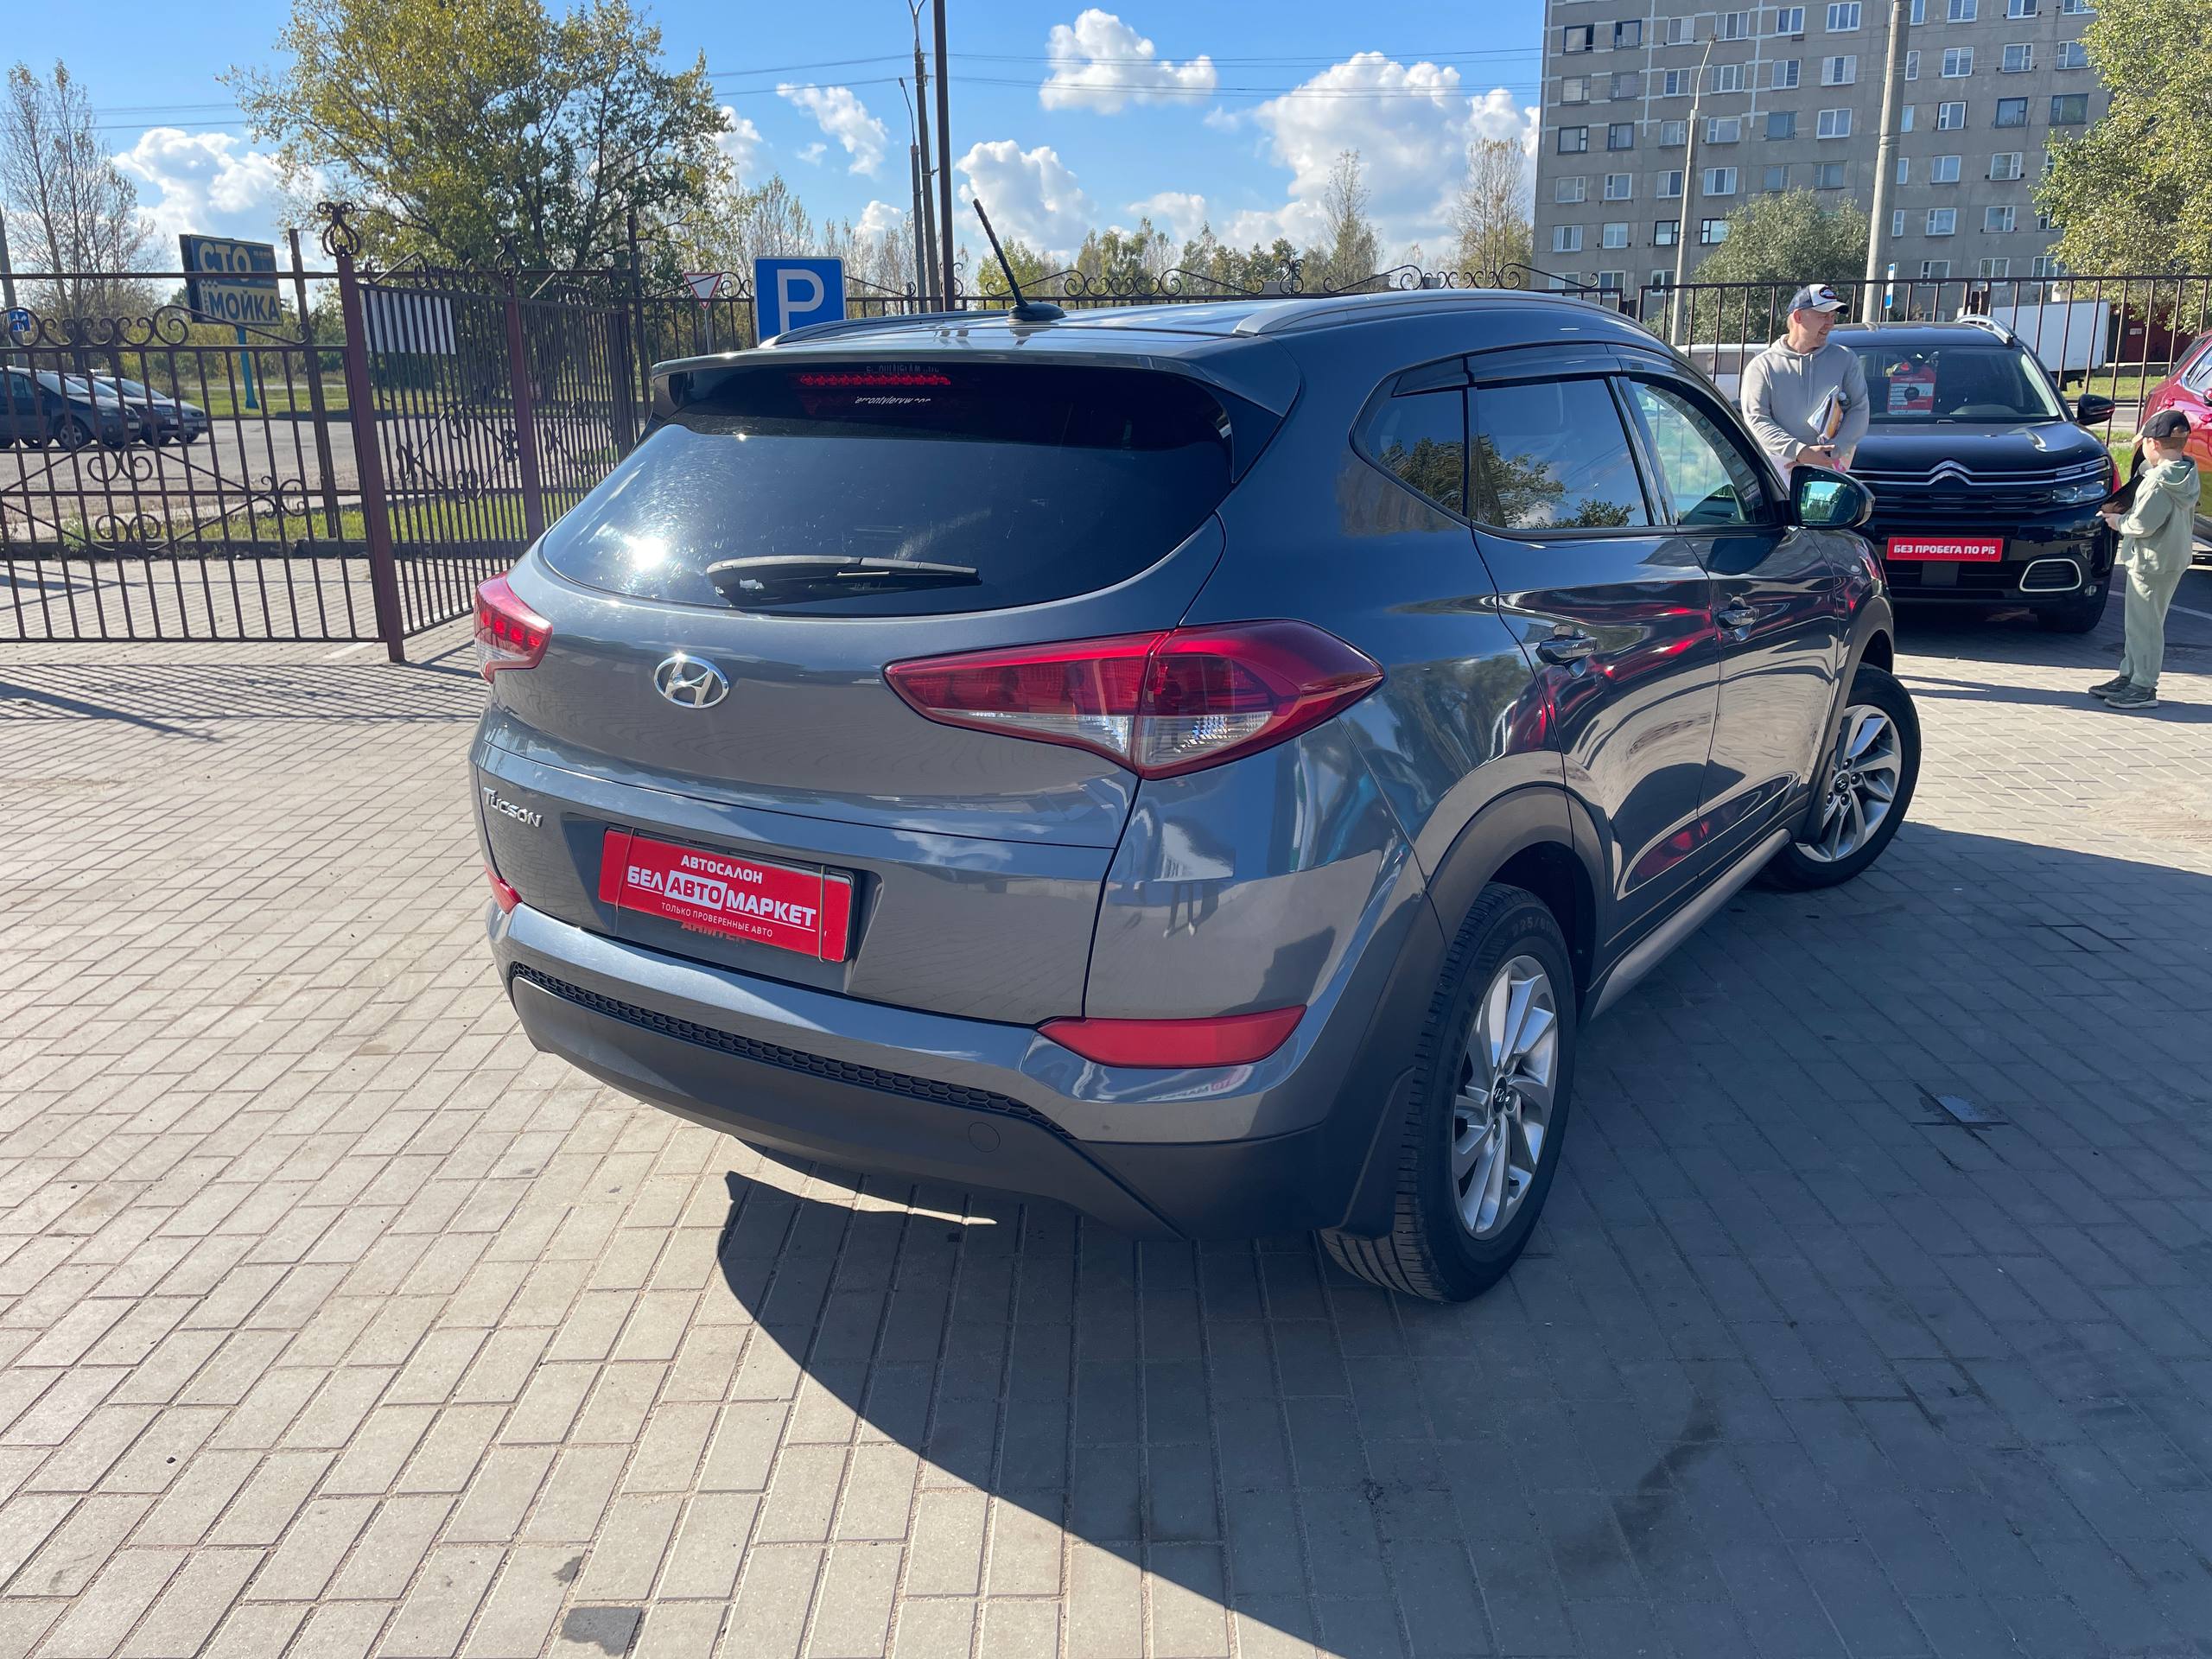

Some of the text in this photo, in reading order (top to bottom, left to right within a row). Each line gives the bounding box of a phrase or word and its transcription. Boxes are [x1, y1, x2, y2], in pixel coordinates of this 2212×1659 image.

[200, 242, 252, 282] СТО
[208, 289, 281, 321] МОЙКА
[777, 269, 824, 334] P
[1893, 544, 1996, 555] БЕЗ ПРОБЕГА ПО РБ
[680, 855, 763, 884] АВТОСАЛОН
[661, 902, 691, 917] ТОЛЬКО
[692, 910, 750, 932] ПРОВЕРЕННЫЕ
[751, 925, 773, 938] АВТО
